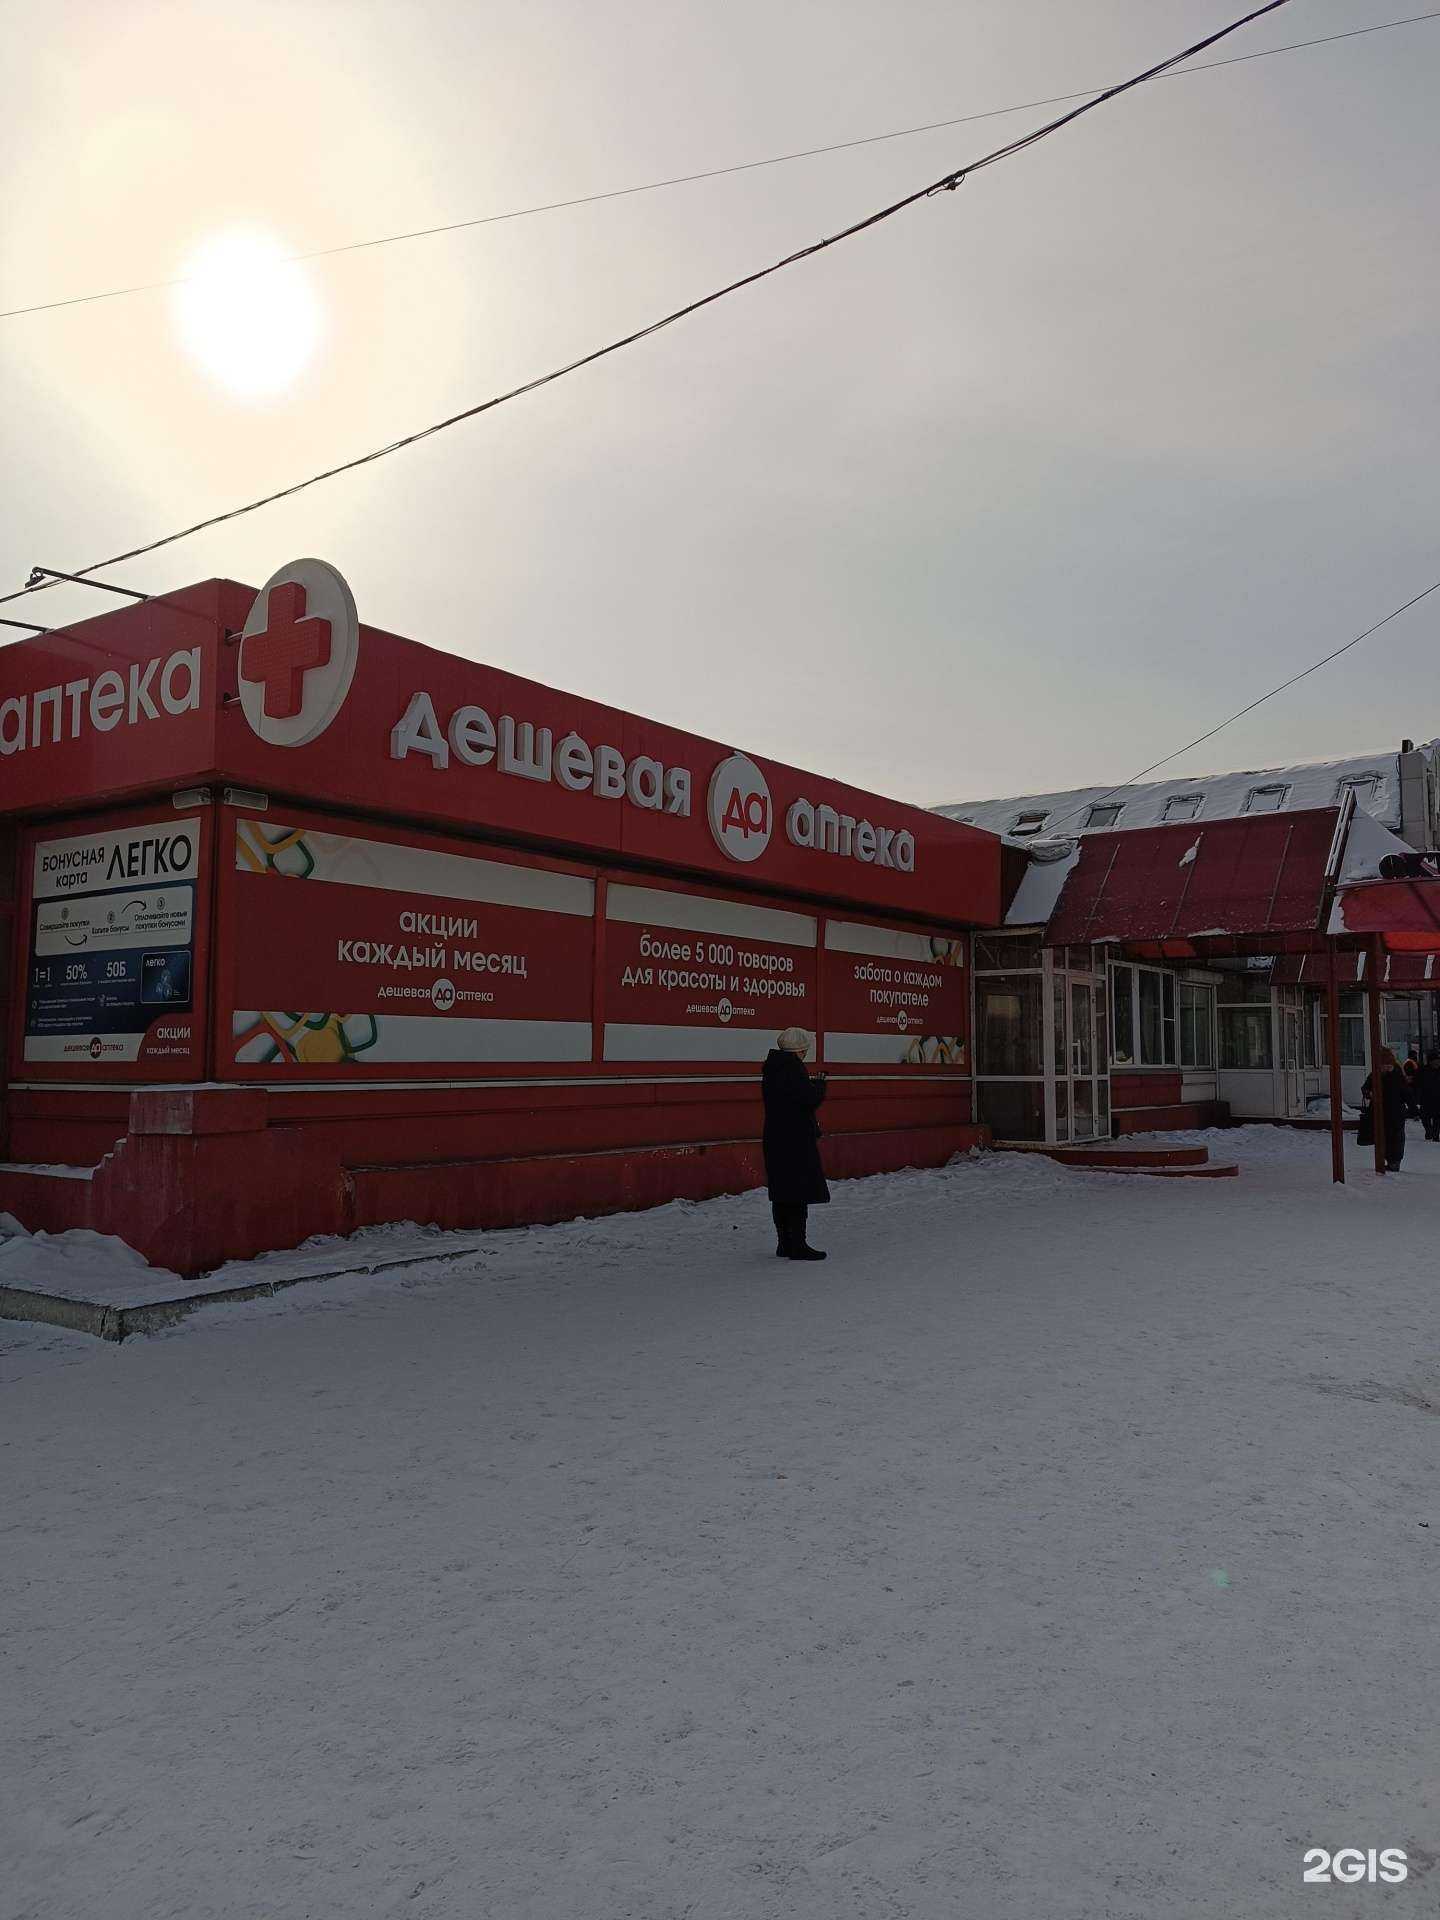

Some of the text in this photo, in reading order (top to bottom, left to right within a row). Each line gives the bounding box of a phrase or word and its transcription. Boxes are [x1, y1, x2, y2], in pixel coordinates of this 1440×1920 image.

[0, 646, 201, 755] аптека
[785, 797, 915, 873] аптека
[42, 846, 105, 872] БОНУСНАЯ
[106, 834, 192, 880] ЛЕГКО
[55, 871, 88, 889] карта
[399, 911, 478, 940] акции
[338, 939, 528, 979] каждый месяц
[640, 934, 691, 961] более
[738, 951, 793, 975] товаров
[65, 963, 88, 980] 50%
[621, 966, 805, 998] для красоты и здоровья
[854, 963, 942, 989] забота о каждом
[377, 986, 431, 1000] дешевая
[456, 990, 494, 1002] аптека
[870, 989, 929, 1007] покупателе
[732, 1006, 755, 1016] аптека
[156, 1027, 191, 1041] акции
